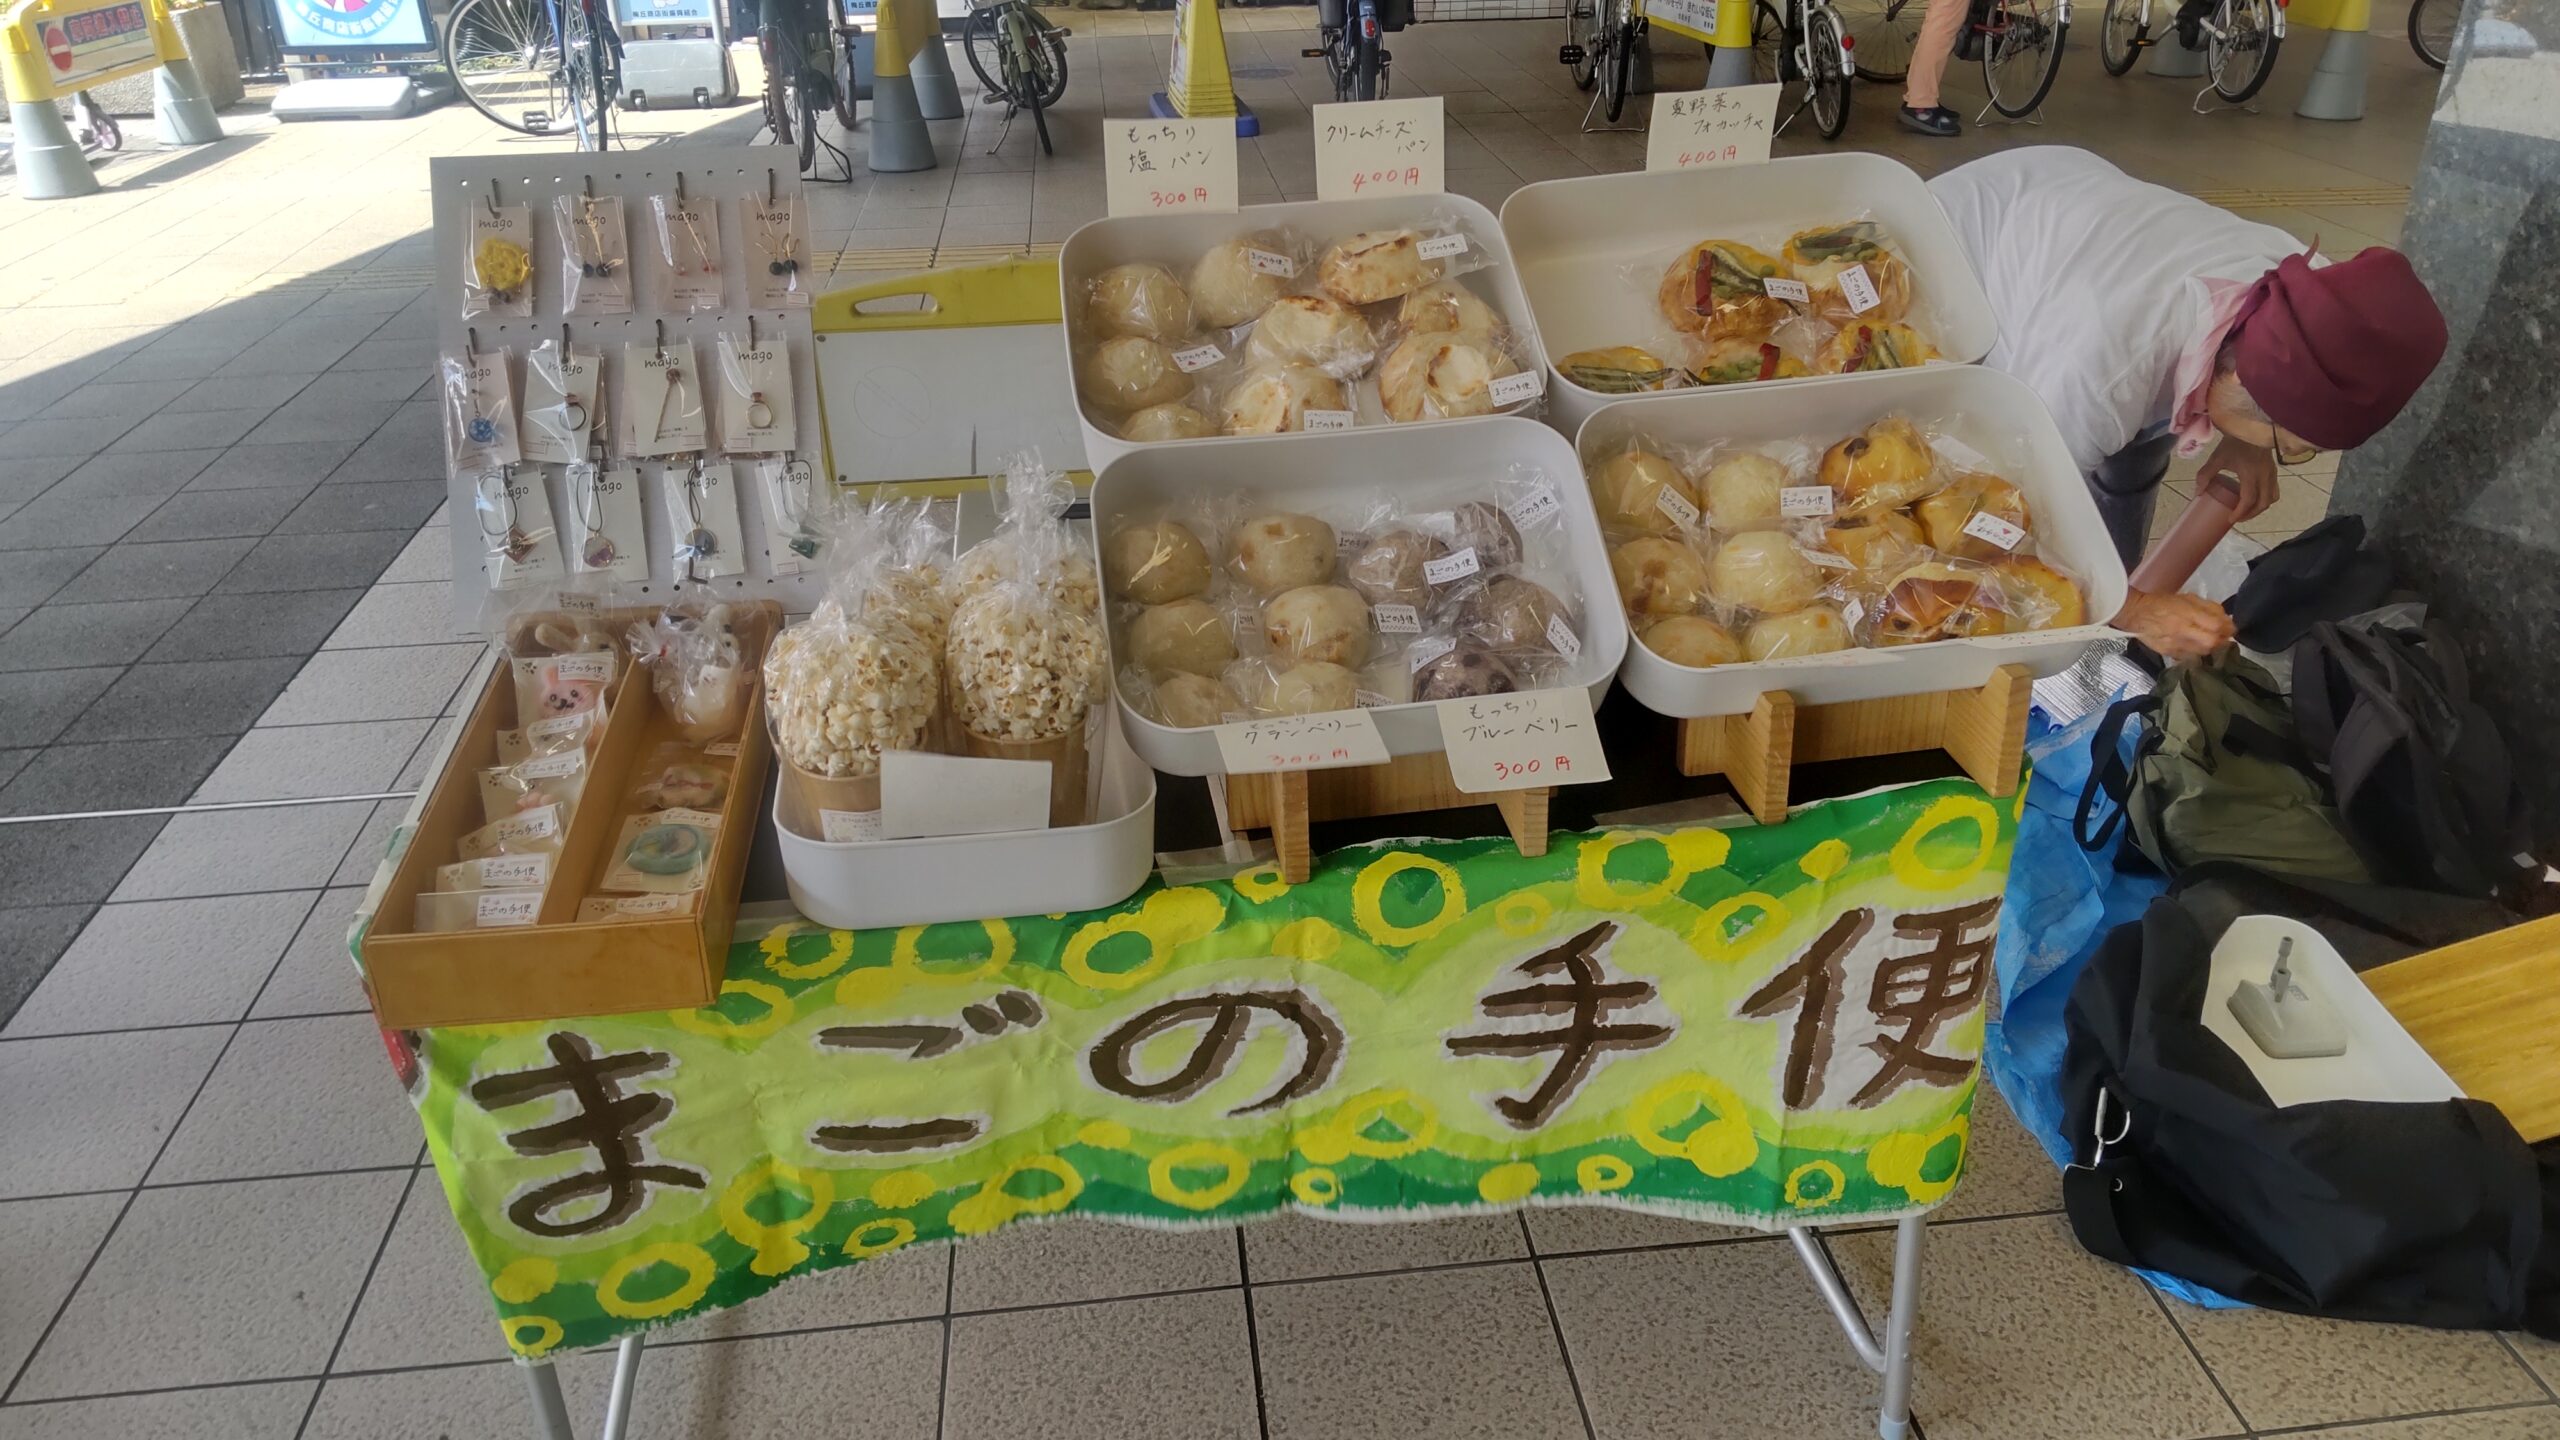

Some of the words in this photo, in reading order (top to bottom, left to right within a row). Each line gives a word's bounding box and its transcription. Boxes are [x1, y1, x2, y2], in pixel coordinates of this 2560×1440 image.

[1671, 92, 1741, 118] 夏野菜の
[1327, 119, 1417, 143] クリームチーズ
[1693, 112, 1763, 135] フォカッチャ
[1128, 126, 1195, 143] もっちり
[1397, 140, 1431, 154] パン
[1679, 145, 1737, 167] 400円
[1353, 167, 1419, 193] 400円
[1151, 187, 1207, 207] 300円
[479, 218, 513, 231] mago
[665, 212, 699, 226] mago
[756, 211, 791, 226] mago
[738, 350, 773, 364] mago
[1429, 558, 1475, 577] まごの手便
[1379, 612, 1417, 625] まごの手便
[1470, 699, 1537, 720] もっちり
[1245, 719, 1362, 744] クランベリー
[1462, 716, 1578, 742] ブルーベリー
[1267, 748, 1348, 766] 300円
[1494, 756, 1571, 780] 300円
[498, 821, 545, 841] まごの手便
[484, 866, 537, 879] まごの手便
[479, 903, 533, 918] まごの手便
[472, 897, 1998, 1238] まごの手便
